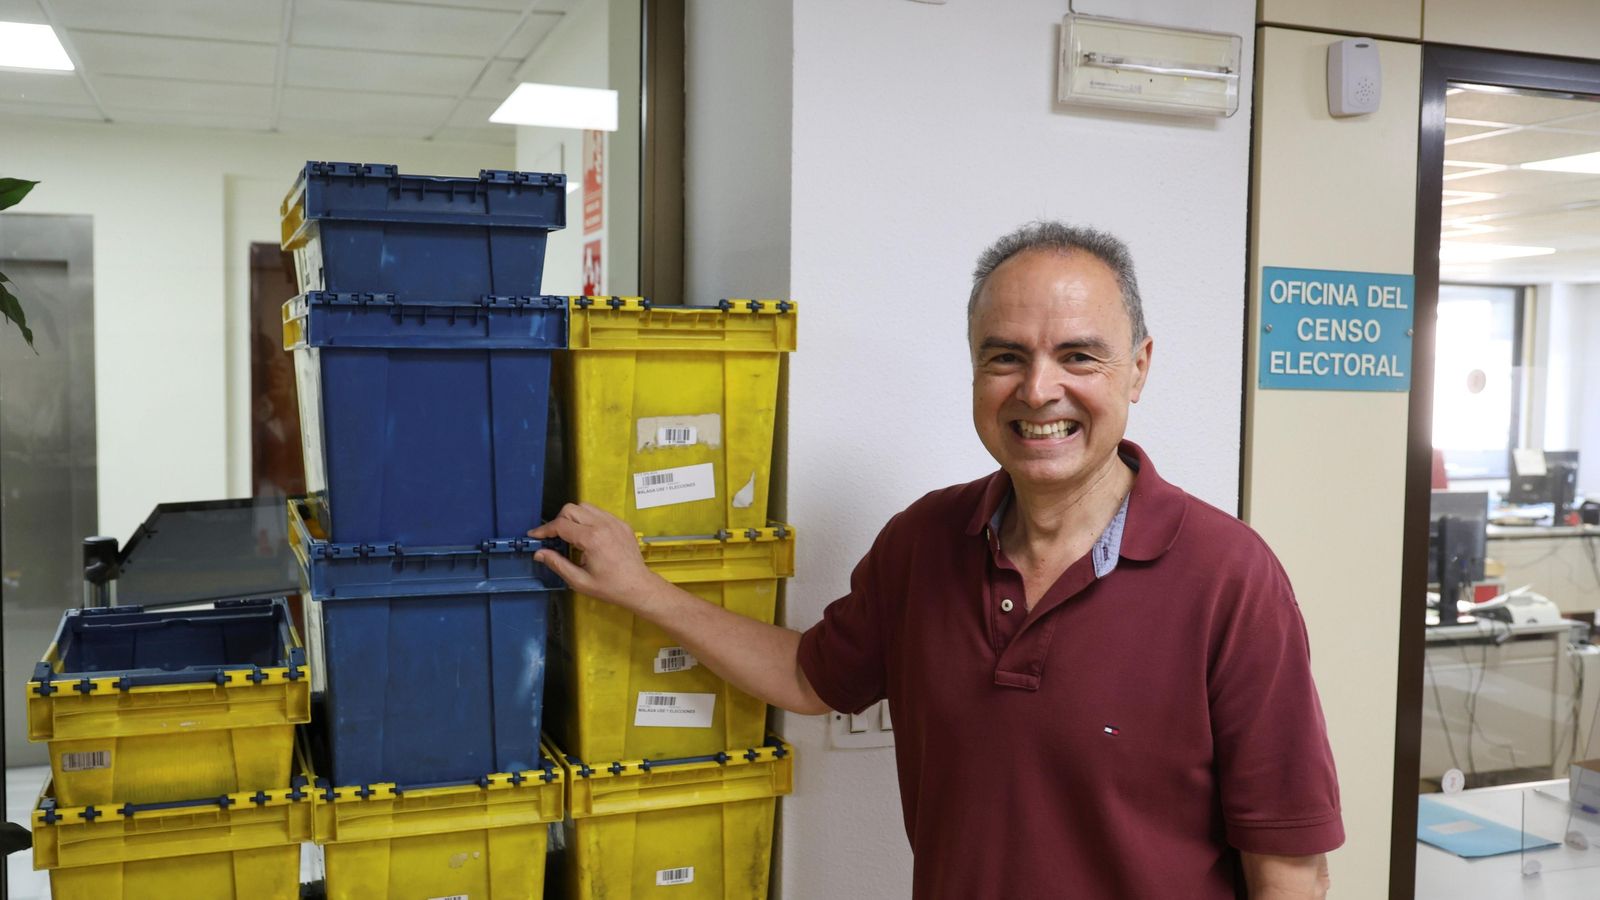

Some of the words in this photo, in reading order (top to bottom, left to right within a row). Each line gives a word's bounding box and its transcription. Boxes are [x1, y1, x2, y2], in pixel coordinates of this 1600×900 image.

[1270, 280, 1359, 307] OFICINA
[1367, 285, 1408, 309] DEL
[1297, 317, 1381, 343] CENSO
[1270, 351, 1404, 377] ELECTORAL
